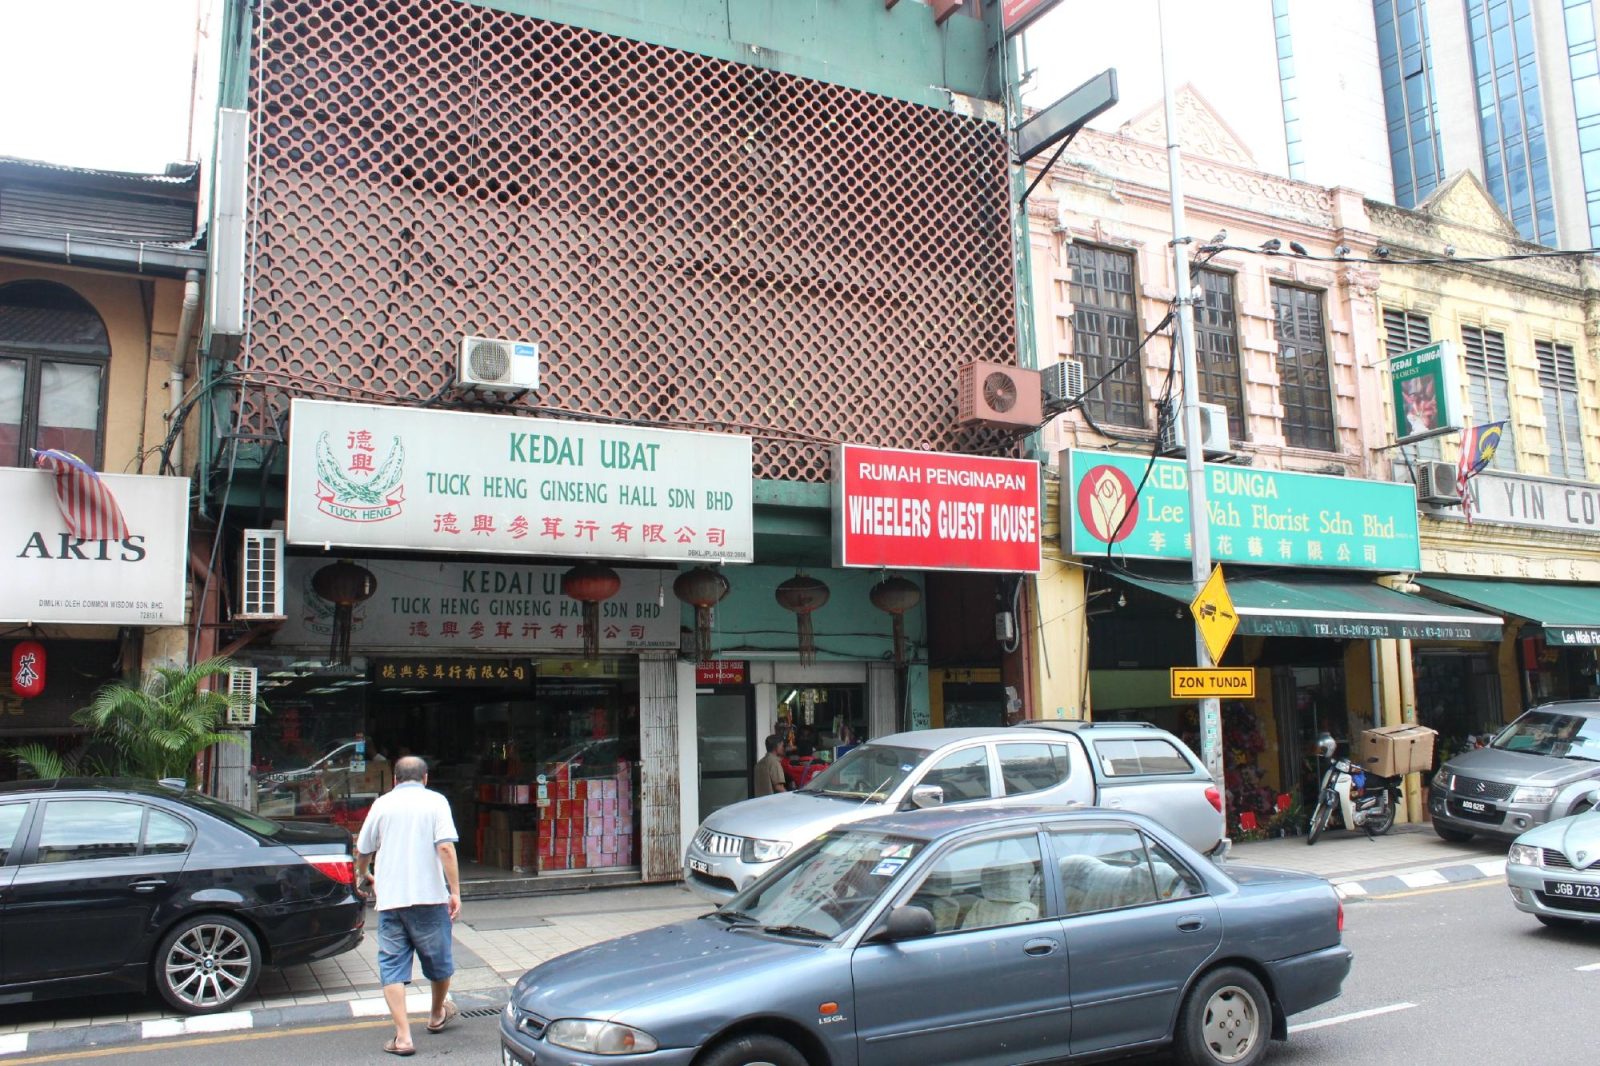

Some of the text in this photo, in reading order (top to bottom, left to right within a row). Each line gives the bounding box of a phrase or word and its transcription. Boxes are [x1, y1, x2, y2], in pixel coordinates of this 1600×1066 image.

[509, 432, 661, 473] KEDAI UBAT
[859, 463, 1026, 491] RUMAH PENGINAPAN
[1144, 463, 1279, 499] KED BUNGA
[426, 472, 734, 512] TUCK HENG GINSENG HALL SDN BHD
[1503, 481, 1545, 520] YIN
[1564, 489, 1600, 525] CO
[329, 504, 392, 520] TUCK HENG
[848, 495, 1036, 543] WHEELERS GUEST HOUSE
[1146, 496, 1184, 523] Lee
[1251, 504, 1311, 532] Florist
[1319, 510, 1354, 536] Sdn
[1362, 513, 1395, 538] Bhd
[16, 531, 147, 562] ARTS
[462, 570, 533, 595] KEDAI
[65, 600, 80, 608] OLEH
[83, 600, 108, 608] COMMON
[111, 600, 134, 608] WISDOM
[391, 597, 431, 614] TUCK
[440, 598, 480, 615] HENG
[489, 599, 551, 616] GINSENG
[603, 602, 628, 618] SDN
[636, 602, 661, 618] BHD
[1254, 620, 1273, 633] Lee
[1275, 620, 1298, 634] Wah
[1561, 630, 1575, 643] Lee
[1575, 630, 1591, 643] Wah
[15, 652, 39, 687] 茶
[1179, 676, 1248, 688] ZON TUNDA
[1554, 883, 1600, 898] JGB 7123
